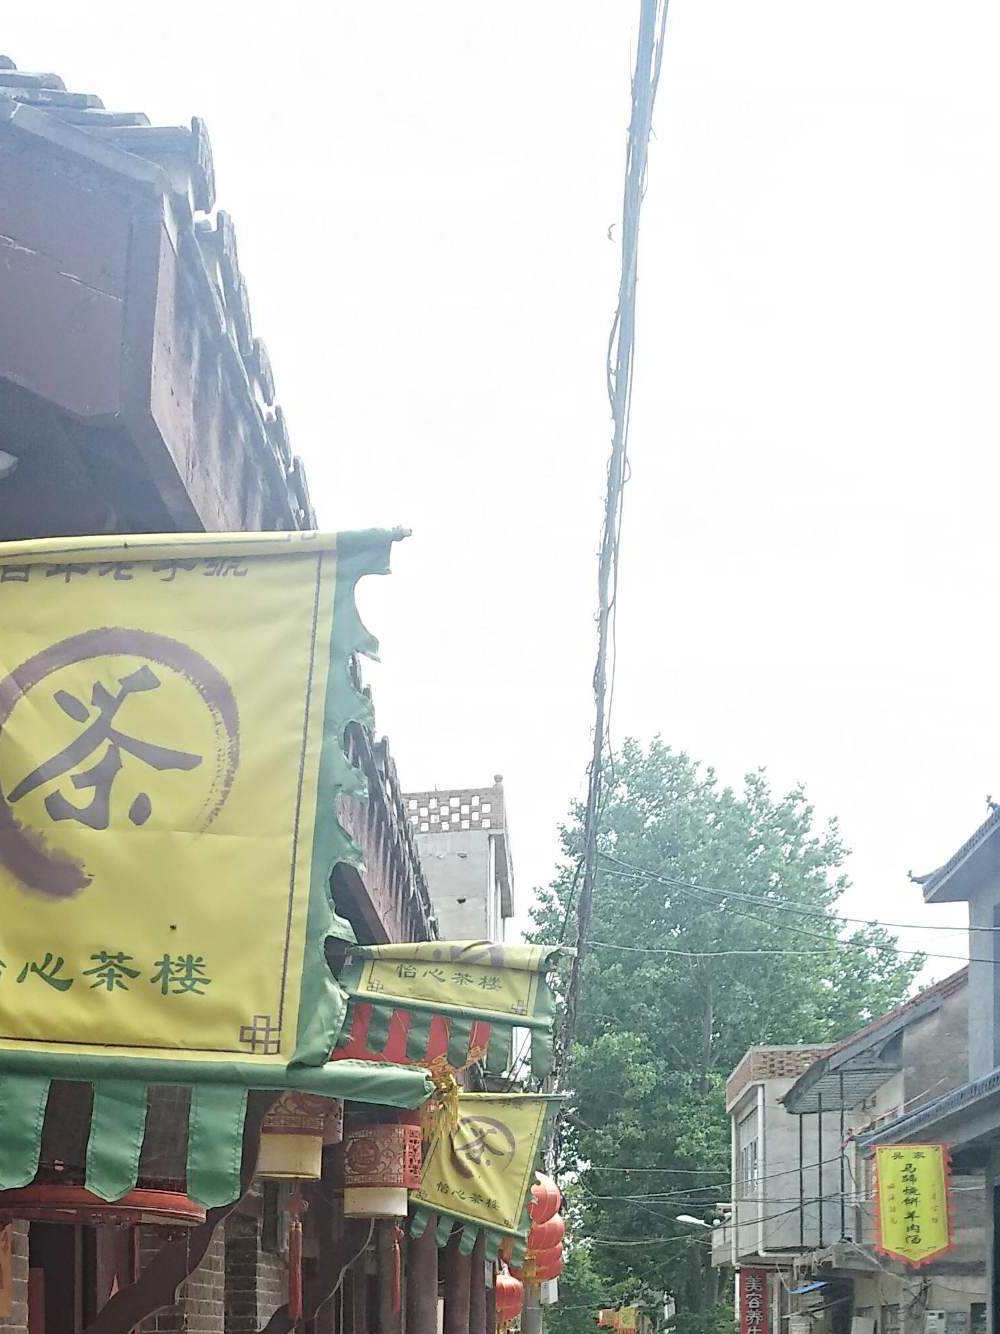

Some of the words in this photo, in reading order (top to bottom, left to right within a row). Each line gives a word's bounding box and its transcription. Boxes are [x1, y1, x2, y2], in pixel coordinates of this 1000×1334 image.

[6, 664, 203, 832] 茶
[396, 963, 503, 991] 怡心茶楼
[435, 1180, 499, 1211] 怡心茶楼
